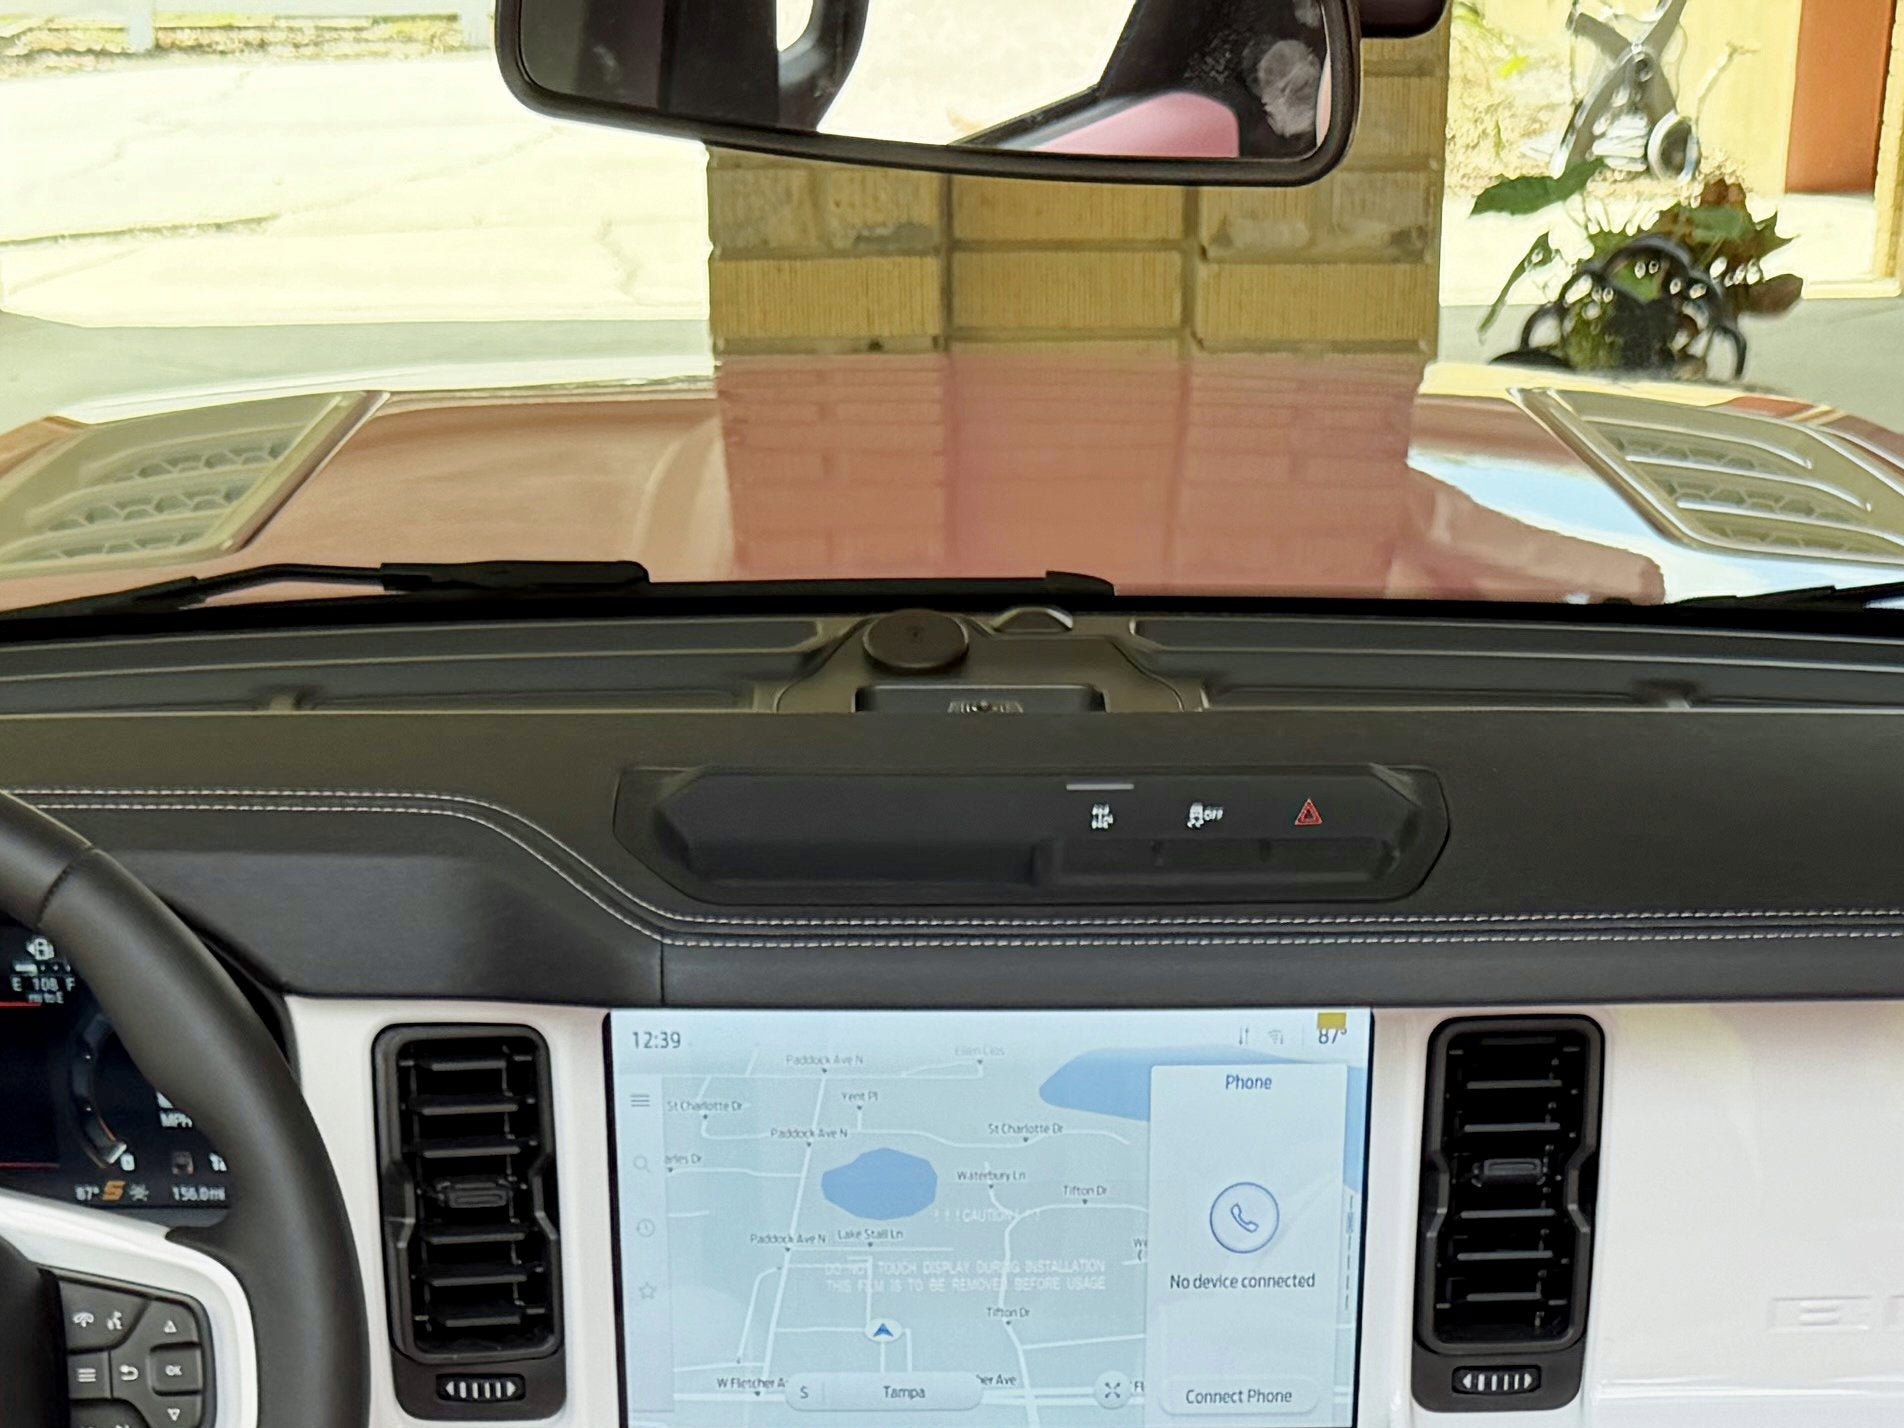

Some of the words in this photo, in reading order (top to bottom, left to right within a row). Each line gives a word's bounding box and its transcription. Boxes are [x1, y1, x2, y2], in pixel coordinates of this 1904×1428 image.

[11, 976, 22, 992] E
[65, 976, 75, 992] F
[632, 1031, 681, 1049] 12:39
[786, 1054, 831, 1066] Paddock
[833, 1055, 852, 1065] Ave
[853, 1054, 863, 1065] N
[1225, 1074, 1272, 1090] Phone
[667, 1101, 679, 1112] St
[680, 1100, 729, 1112] Charlotte
[732, 1101, 742, 1111] Dr
[771, 1128, 815, 1139] Paddock
[817, 1128, 835, 1139] Ave
[838, 1128, 847, 1138] N
[988, 1123, 999, 1134] St
[1002, 1123, 1049, 1134] Charlotte
[1053, 1123, 1063, 1134] Dr
[691, 1154, 702, 1164] Dr
[957, 1170, 1009, 1183] Waterbury
[1013, 1171, 1026, 1181] Ln
[1063, 1185, 1094, 1195] Tifton
[1097, 1186, 1107, 1195] Dr
[750, 1233, 793, 1244] Paddock
[796, 1234, 816, 1243] Ave
[817, 1234, 826, 1243] N
[838, 1230, 862, 1240] Lake
[864, 1229, 889, 1240] Stall
[891, 1230, 903, 1239] Ln
[923, 1260, 969, 1274] DISPLAY
[1170, 1274, 1190, 1289] No
[1193, 1273, 1238, 1289] device
[1241, 1273, 1316, 1289] connected
[1019, 1307, 1030, 1317] Dr
[165, 1364, 183, 1376] OK
[717, 1378, 728, 1389] W
[730, 1377, 775, 1389] Fletcher
[996, 1374, 1017, 1386] Ave
[800, 1387, 809, 1399] S
[883, 1386, 926, 1400] Tampa
[1186, 1389, 1244, 1405] Connect
[1247, 1388, 1293, 1404] Phone
